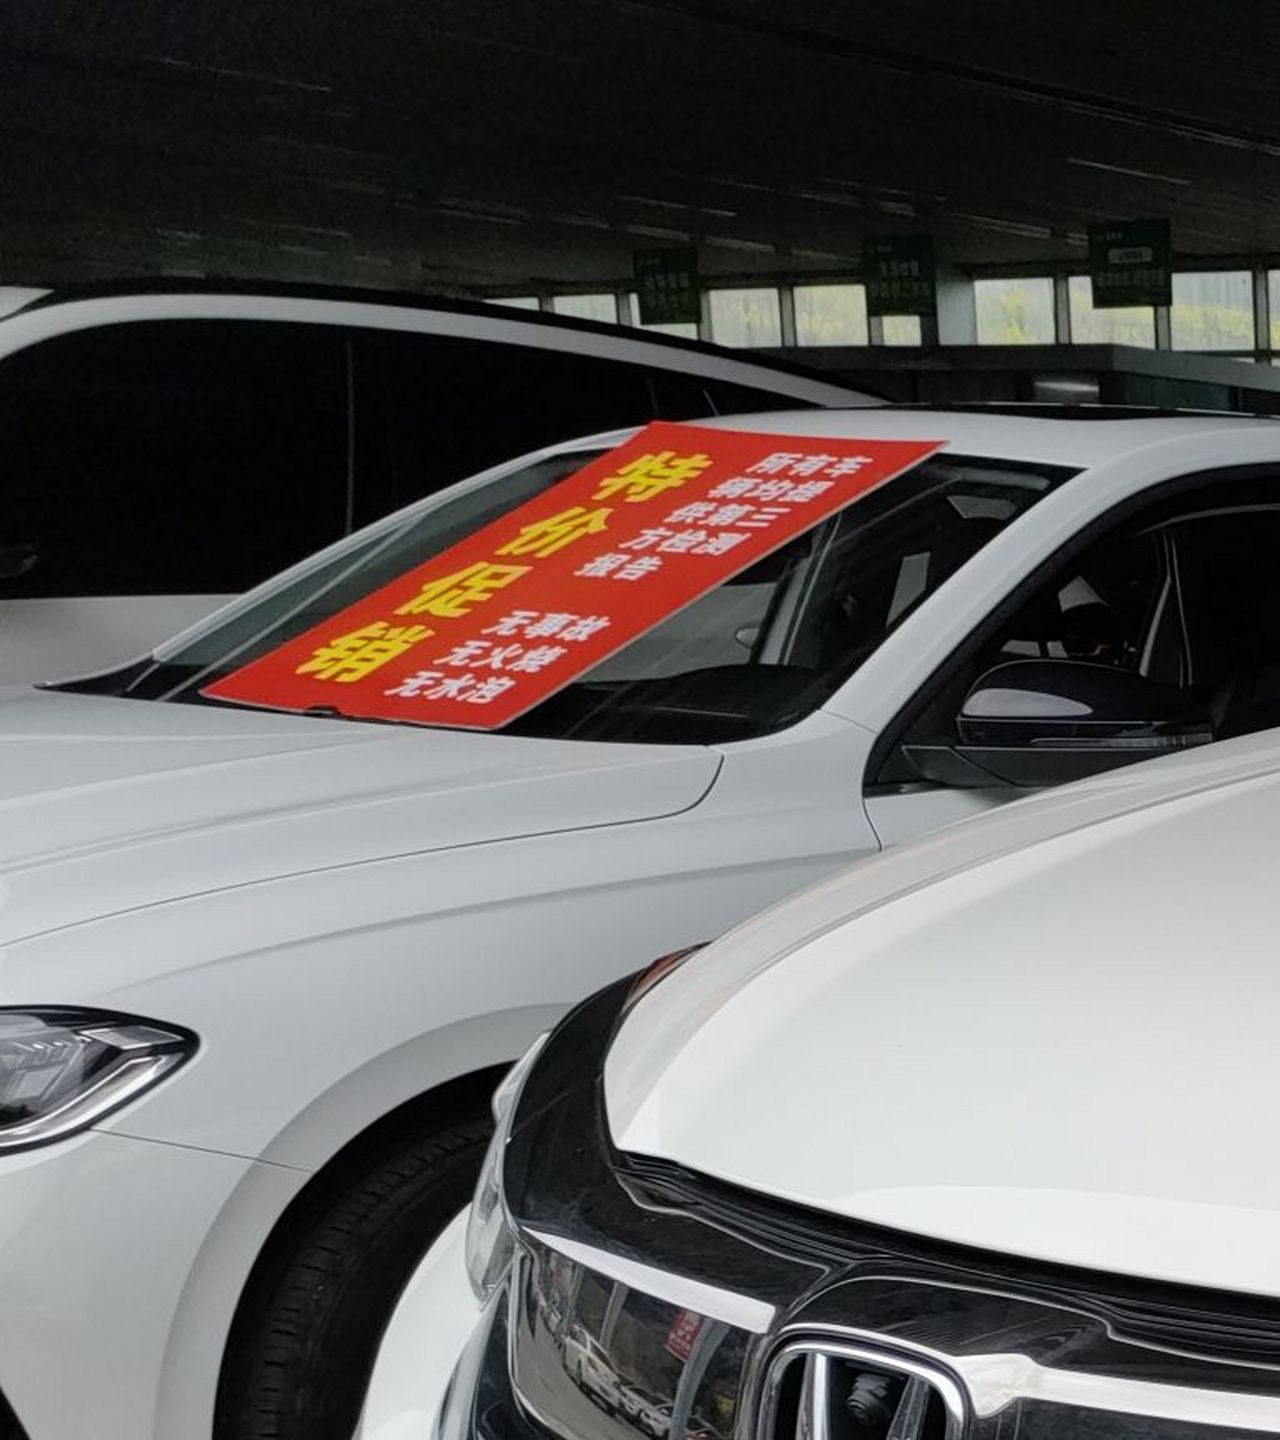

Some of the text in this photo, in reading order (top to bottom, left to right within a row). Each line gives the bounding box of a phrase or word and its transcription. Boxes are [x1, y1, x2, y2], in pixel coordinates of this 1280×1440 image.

[746, 453, 873, 477] 所有车
[707, 476, 835, 502] 辆均提
[663, 502, 791, 527] 供第三
[619, 527, 752, 555] 方检测
[296, 450, 713, 683] 特价促销
[574, 552, 663, 580] 报告
[482, 610, 611, 641] 无事故
[433, 640, 567, 673] 无火烧
[384, 670, 516, 704] 无水泡
